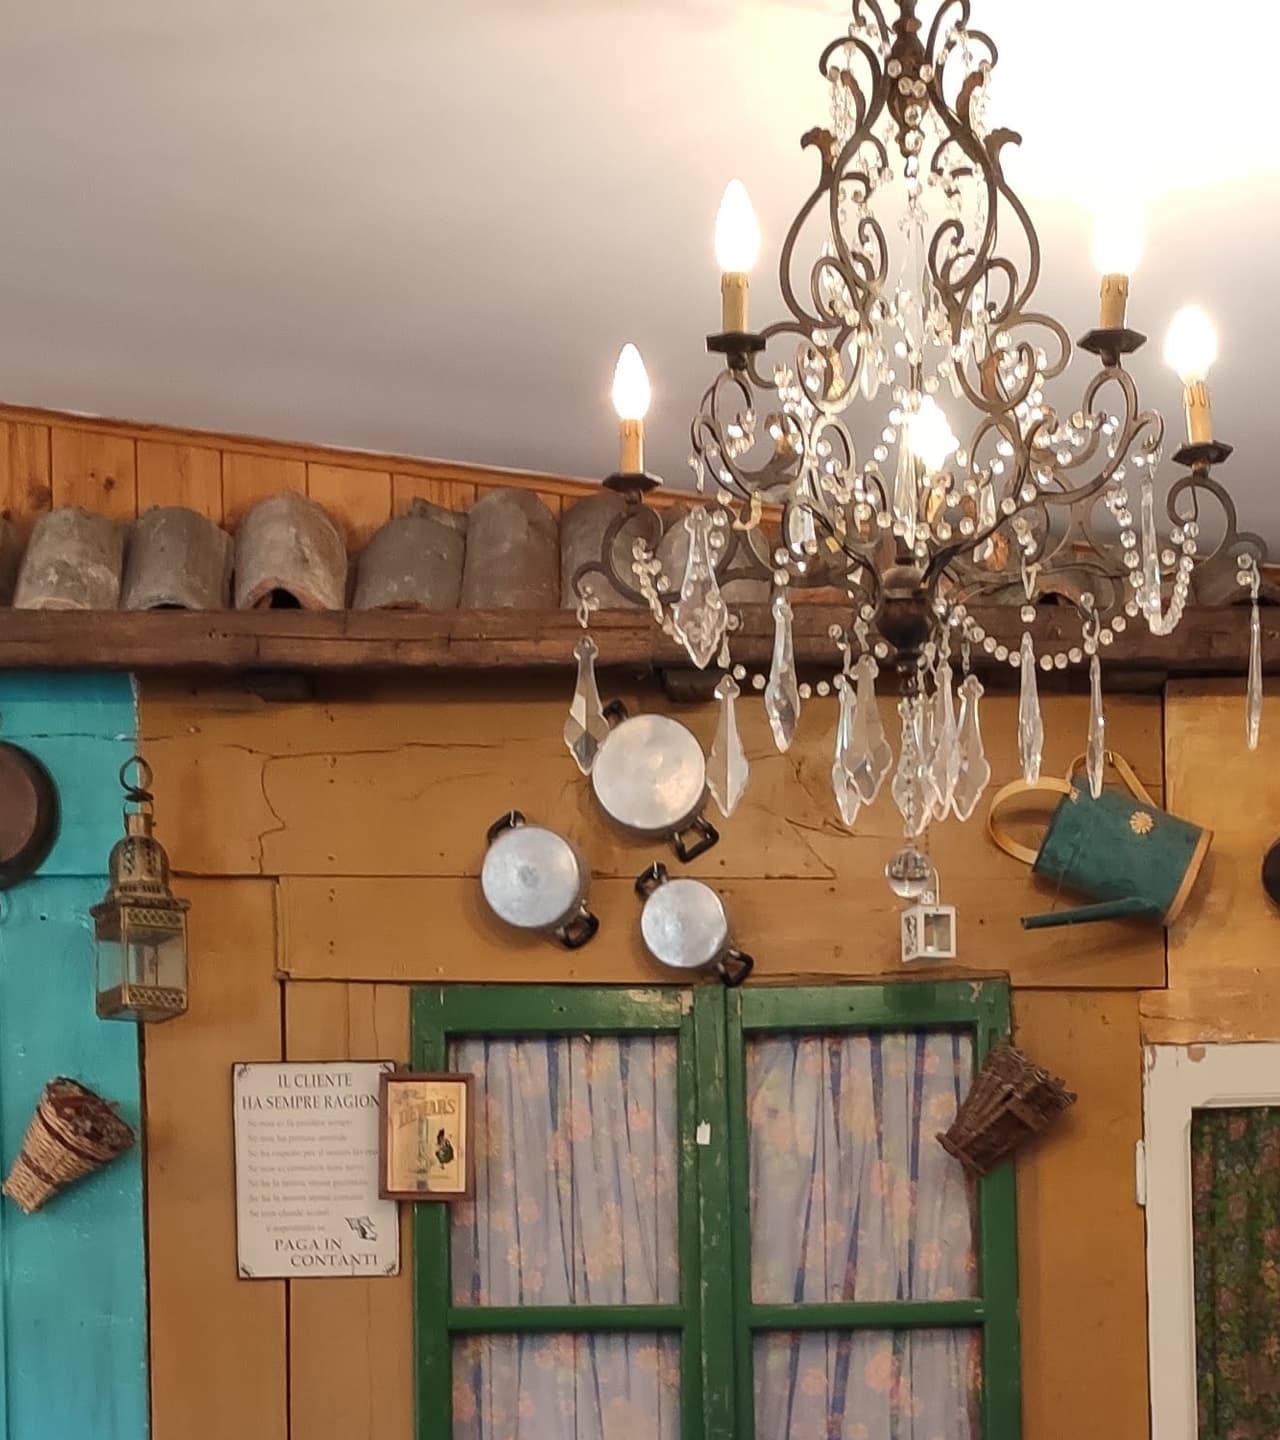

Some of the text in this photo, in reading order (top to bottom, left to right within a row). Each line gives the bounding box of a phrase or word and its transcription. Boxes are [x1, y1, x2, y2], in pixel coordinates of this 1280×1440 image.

[278, 1072, 352, 1088] IL CLIENTE
[242, 1095, 262, 1110] HA
[266, 1094, 320, 1110] SEMPRE
[324, 1093, 380, 1109] RAGION
[274, 1238, 342, 1251] PAGA IN
[290, 1253, 377, 1267] CONTANTI
